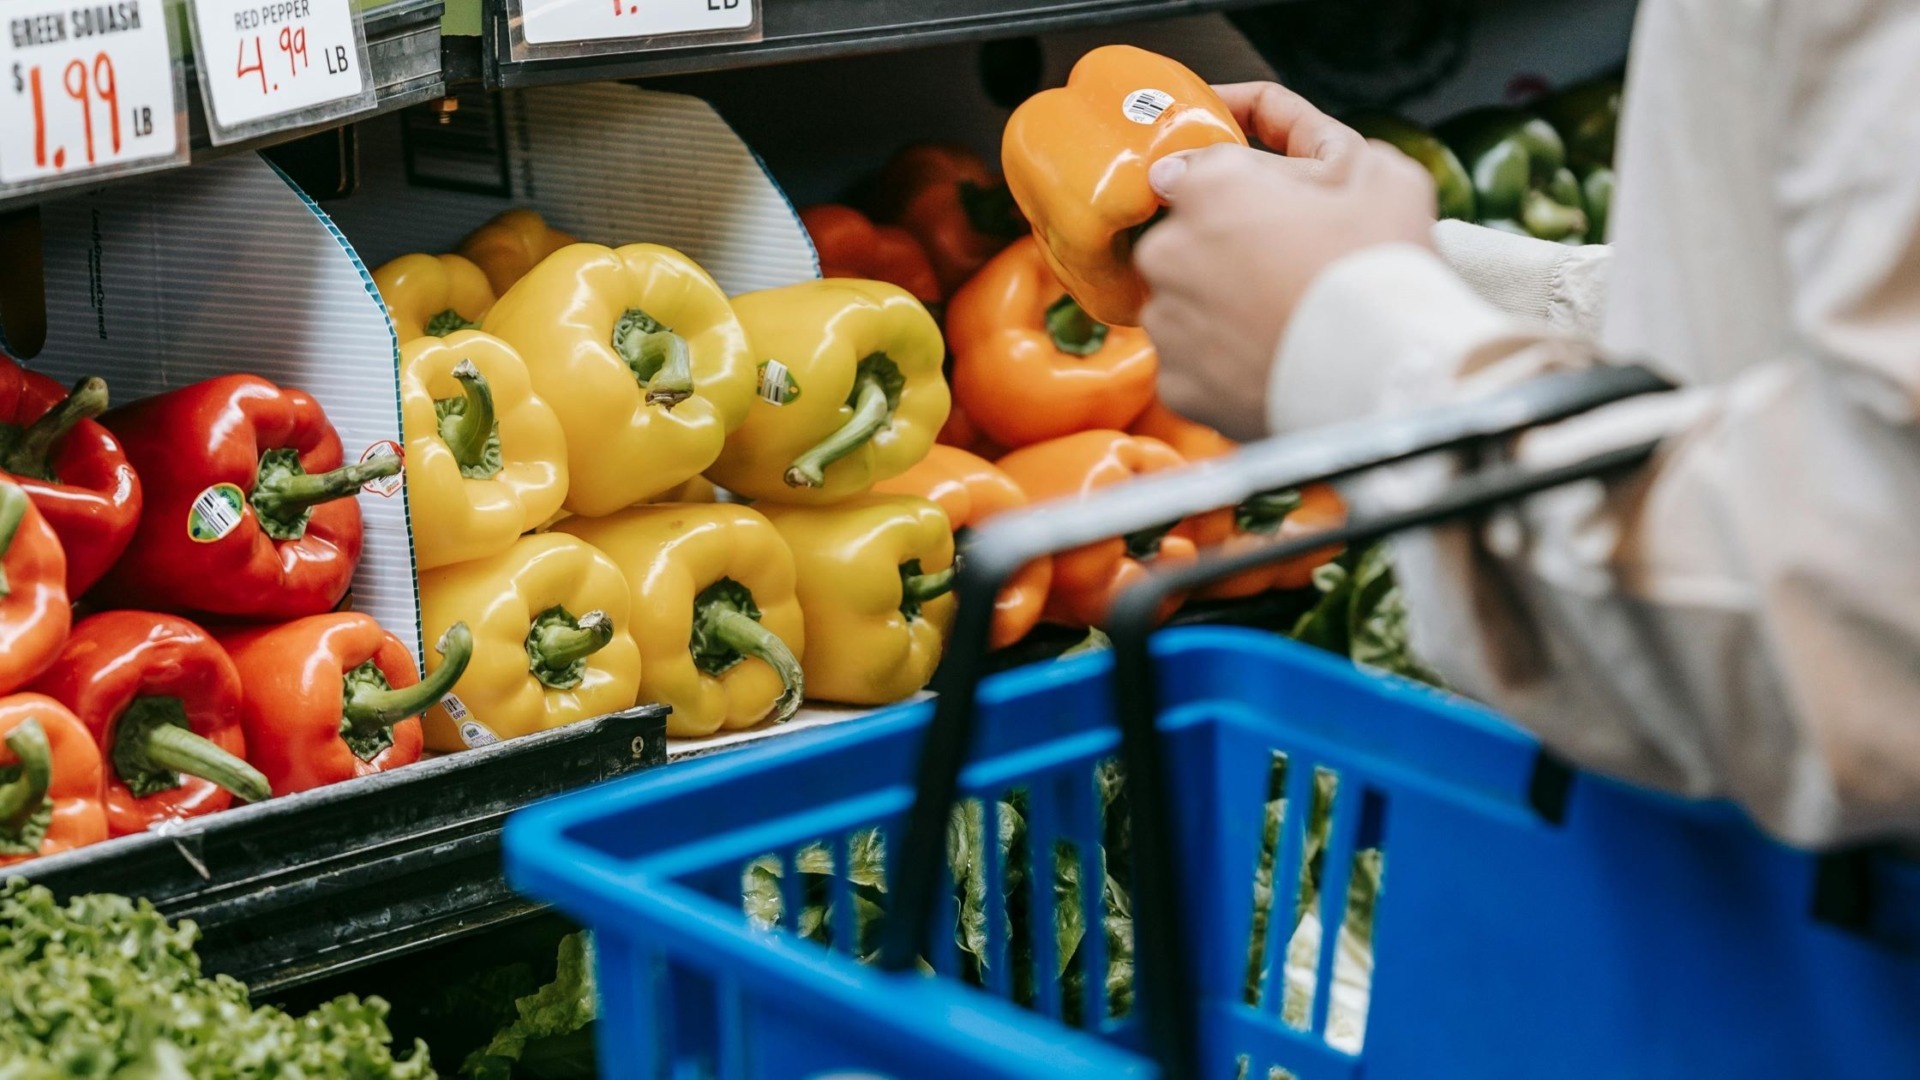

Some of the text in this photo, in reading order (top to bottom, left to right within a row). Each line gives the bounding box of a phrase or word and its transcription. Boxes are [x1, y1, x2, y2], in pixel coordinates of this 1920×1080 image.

[11, 0, 140, 47] GREEN SQUASH
[234, 0, 310, 31] RED PEPPER
[237, 26, 308, 94] 4.99
[324, 45, 348, 75] LB
[133, 107, 153, 137] LB
